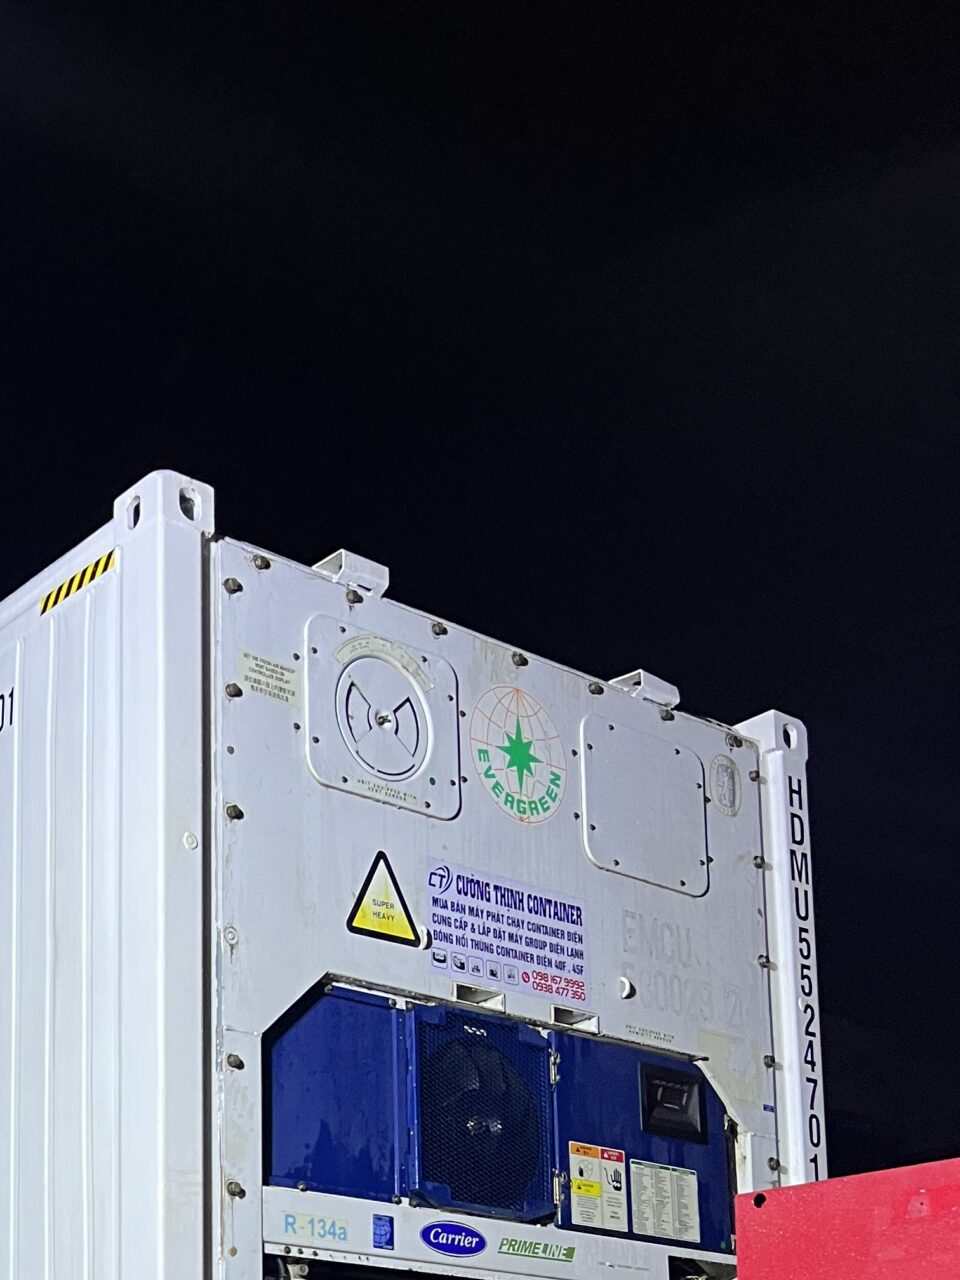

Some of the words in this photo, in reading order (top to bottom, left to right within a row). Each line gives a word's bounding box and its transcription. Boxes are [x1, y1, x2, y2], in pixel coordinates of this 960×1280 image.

[477, 748, 562, 817] EVERGREEN
[372, 898, 395, 910] SUPER
[493, 884, 524, 912] THỊNH
[527, 893, 583, 926] CONTAINER
[372, 911, 395, 922] HEAVY
[432, 896, 448, 911] MUA
[527, 921, 565, 940] CONTAINER
[432, 912, 452, 928] CUNG
[470, 922, 476, 934] &
[525, 936, 548, 951] GROUP
[495, 944, 535, 964] CONTAINER
[531, 970, 549, 983] 098
[550, 973, 563, 985] 167
[532, 980, 554, 994] 0938
[554, 986, 570, 998] 477
[430, 1228, 480, 1248] Carrier
